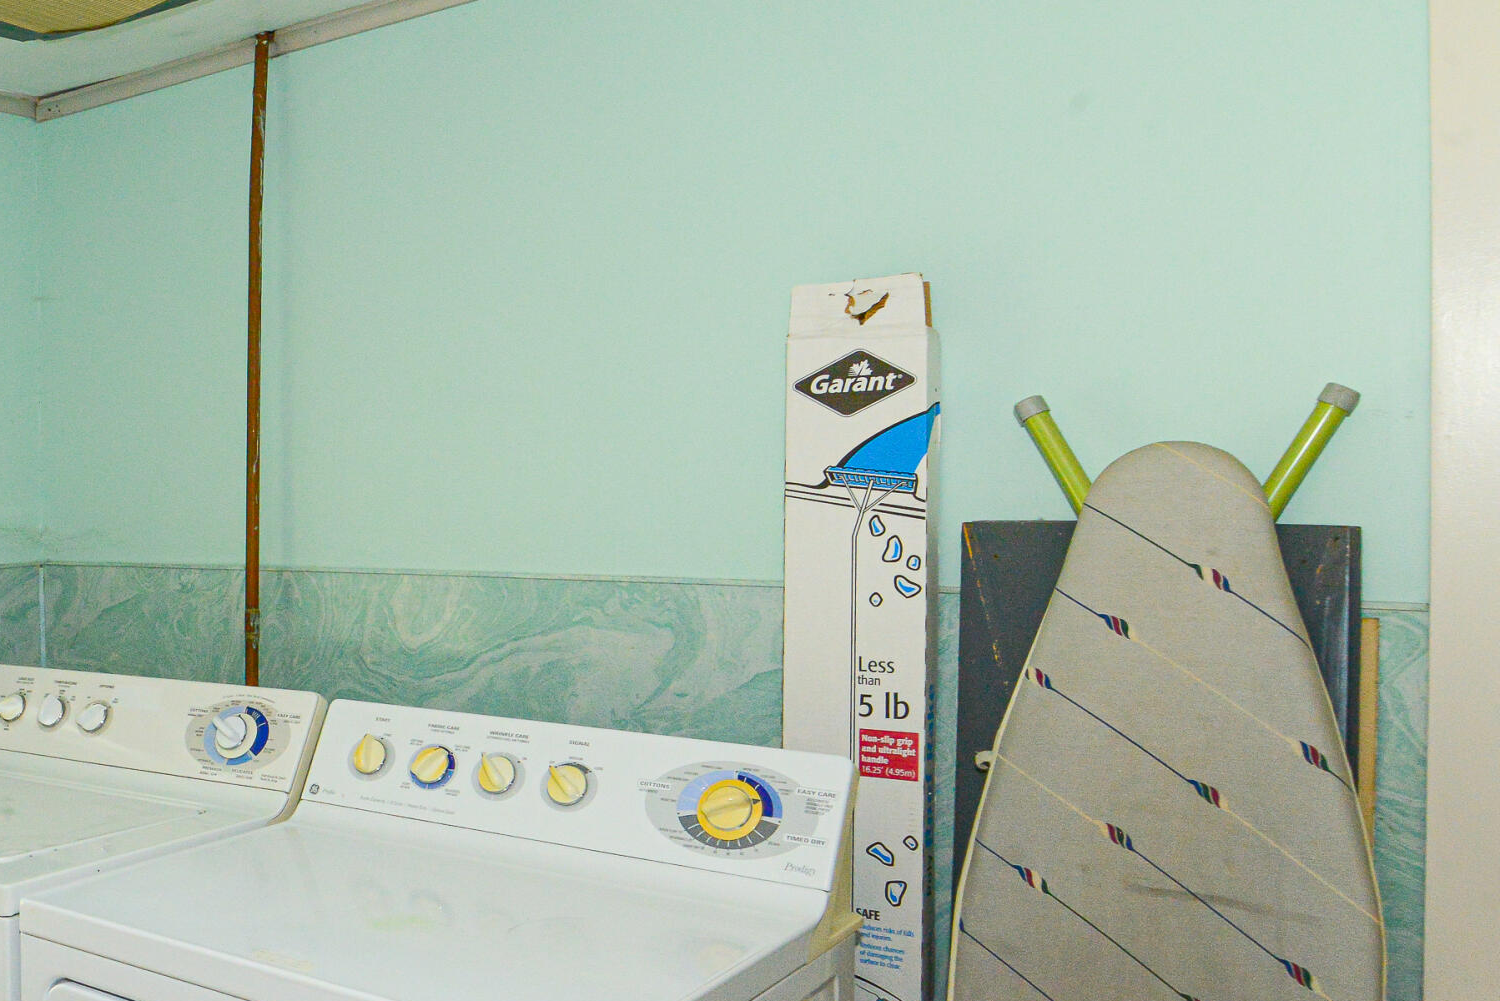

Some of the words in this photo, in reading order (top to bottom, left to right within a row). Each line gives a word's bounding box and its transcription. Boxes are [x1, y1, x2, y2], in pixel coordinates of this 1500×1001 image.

[810, 372, 897, 394] Garant
[858, 655, 895, 674] Less
[857, 675, 881, 686] than
[858, 693, 873, 717] 5
[885, 691, 910, 719] lb
[861, 734, 895, 746] Non-slip
[896, 737, 913, 747] grip
[861, 744, 876, 752] and
[878, 746, 916, 757] ultralight
[861, 754, 889, 764] handle
[885, 766, 916, 778] (4.95m)
[797, 788, 816, 796] EASY
[818, 791, 837, 799] CARE
[856, 907, 880, 921] SAFE
